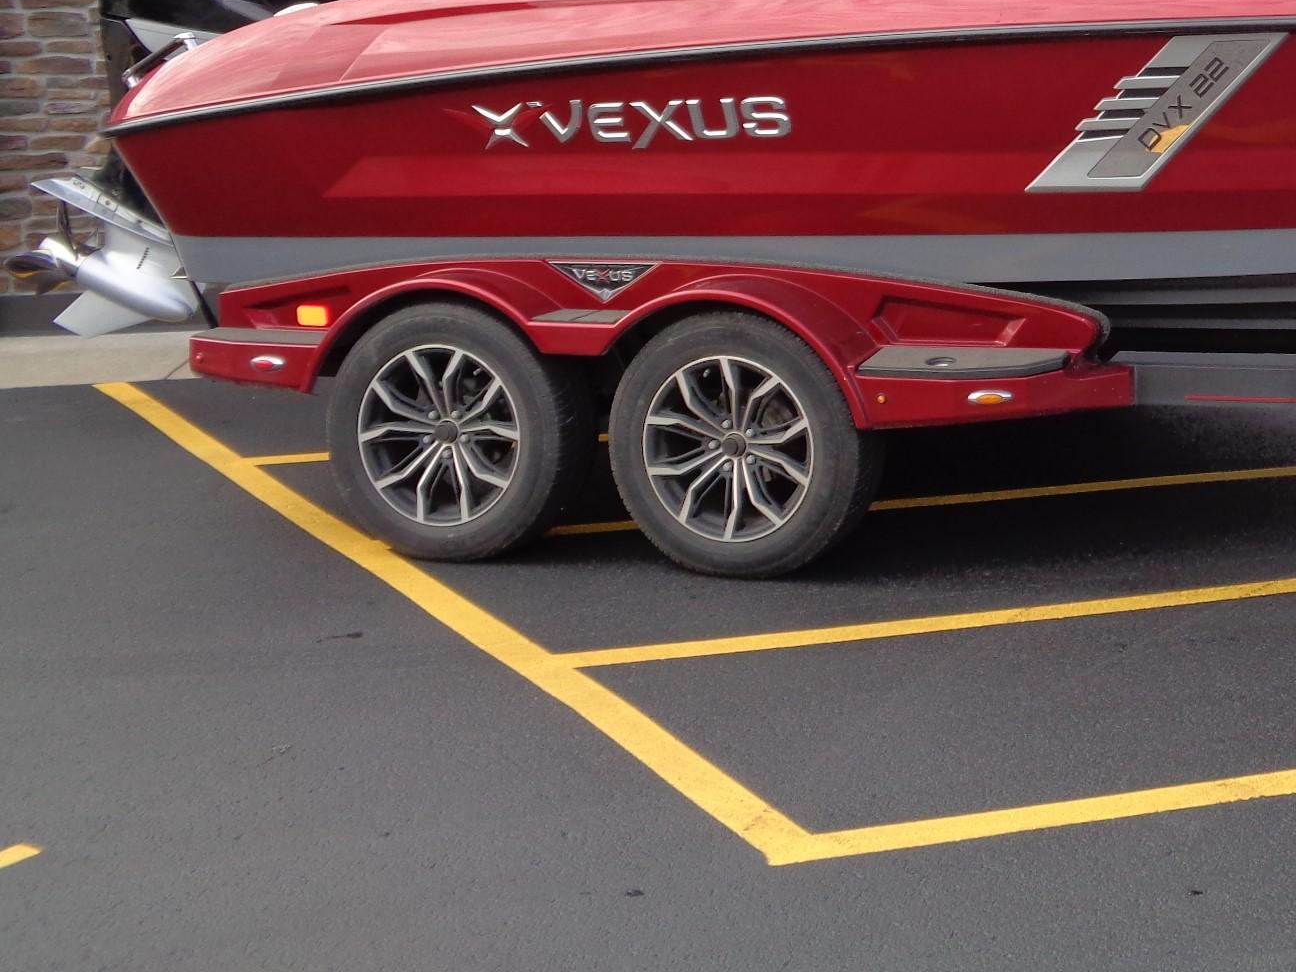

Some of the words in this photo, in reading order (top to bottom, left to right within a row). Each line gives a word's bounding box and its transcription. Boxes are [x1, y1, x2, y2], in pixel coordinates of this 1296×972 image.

[538, 96, 792, 150] VEXUS
[1138, 94, 1192, 151] DVX
[1189, 56, 1229, 98] 22
[571, 268, 634, 283] VEXUS
